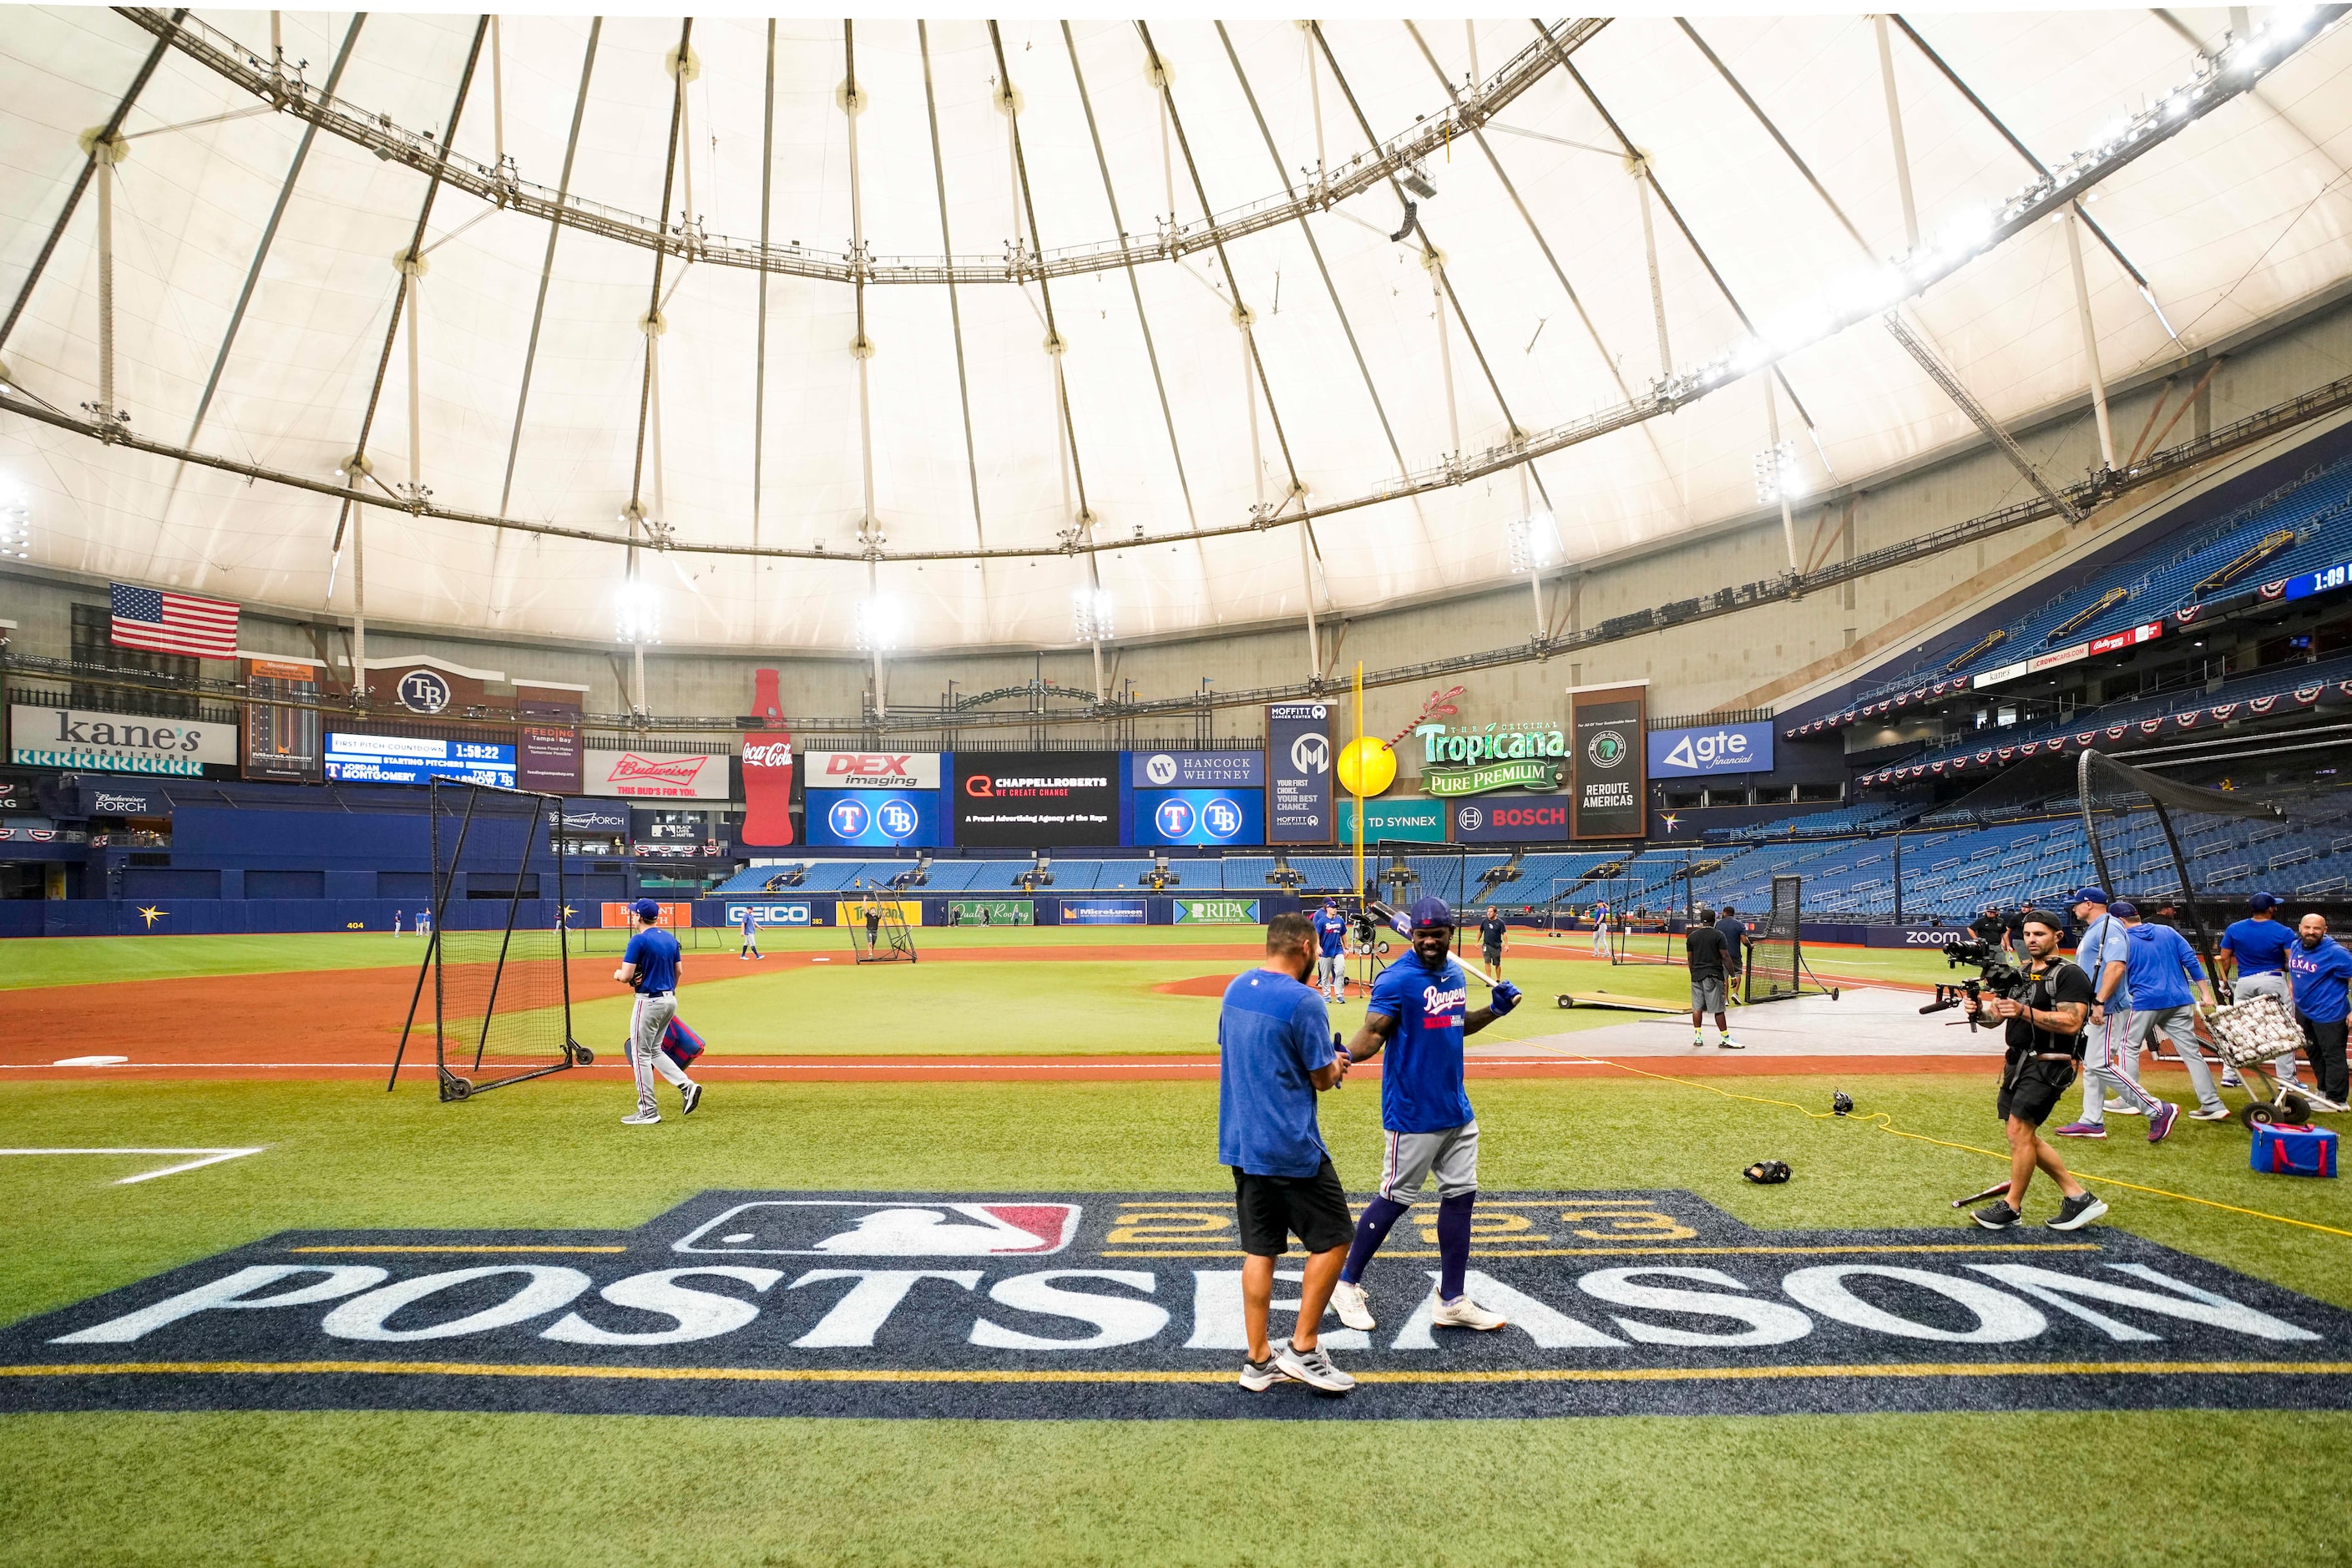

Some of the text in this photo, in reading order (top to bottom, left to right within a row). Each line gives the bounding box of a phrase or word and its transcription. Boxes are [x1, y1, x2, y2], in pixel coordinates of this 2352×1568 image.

[2314, 566, 2344, 591] 1:09
[2036, 648, 2085, 667] CROWNCARS.COM
[56, 711, 201, 751] kane's
[1501, 721, 1558, 731] ORIGINAL
[524, 727, 574, 741] FEEDING
[388, 744, 444, 752] COUNTDOWN
[1415, 724, 1565, 766] Tropicana
[1697, 731, 1748, 761] gte
[71, 746, 188, 761] FURNITURE
[252, 752, 312, 761] MicroLumen
[742, 742, 792, 767] Coca-Cola
[1706, 752, 1753, 769] financial
[383, 756, 465, 769] STARTING PITCHERS
[616, 761, 698, 776] Budweiser
[826, 755, 911, 775] DEX
[1183, 759, 1251, 767] HANCOCK
[342, 771, 417, 781] MONTGOMERY
[845, 776, 918, 787] imaging
[995, 778, 1107, 787] CHAPPELLROBERTS
[1183, 770, 1251, 780] WHITNEY
[1432, 765, 1545, 792] PURE PREMIUM
[637, 787, 660, 796] BUD'S
[680, 788, 697, 797] YOU.
[1586, 782, 1630, 796] REROUTE
[95, 792, 146, 802] Budweiser
[1583, 795, 1633, 807] AMERICAS
[95, 801, 147, 812] PORCH
[591, 816, 625, 825] PORCH
[883, 807, 911, 832] TB
[1208, 806, 1236, 831] TB
[1368, 816, 1436, 828] TD SYNNEX
[1493, 808, 1565, 827] BOSCH
[620, 906, 674, 915] BANT
[730, 907, 807, 923] GEICO
[994, 903, 1029, 921] Roofng
[1206, 903, 1244, 918] RIPA
[1905, 931, 1960, 943] zoom
[1423, 985, 1465, 1011] Rangers
[1106, 1213, 1697, 1243] 223
[46, 1264, 2324, 1350] POSTSEASON
